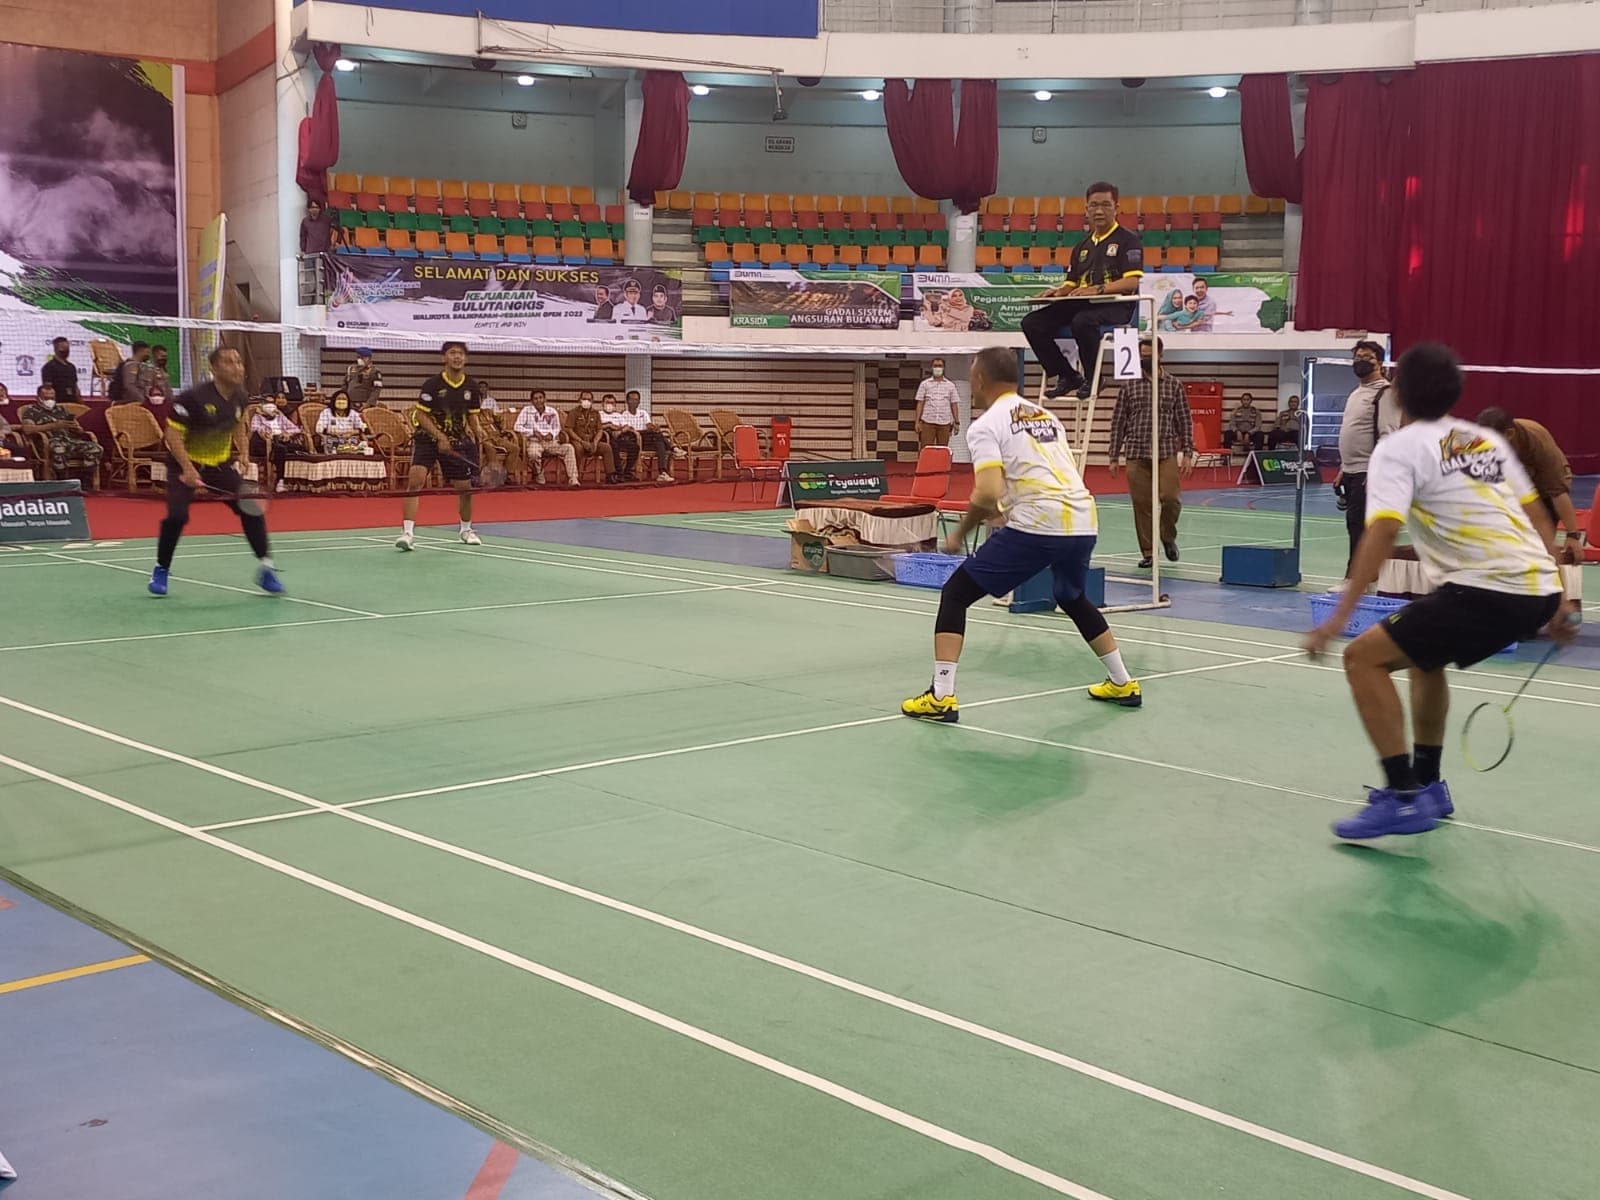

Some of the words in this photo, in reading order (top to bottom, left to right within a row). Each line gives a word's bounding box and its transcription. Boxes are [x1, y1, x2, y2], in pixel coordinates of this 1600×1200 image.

[414, 266, 490, 279] SELAMAT
[496, 269, 530, 280] DAN
[536, 270, 599, 283] SUKSES
[465, 291, 535, 300] KEJUARAAN
[453, 301, 545, 312] BULUTANGKIS
[825, 308, 855, 316] GADAI
[860, 308, 892, 316] SISTEM
[733, 317, 768, 325] KRASIDA
[790, 314, 843, 323] ANGSURAN
[846, 315, 892, 324] BULANAN
[1120, 346, 1135, 376] 2
